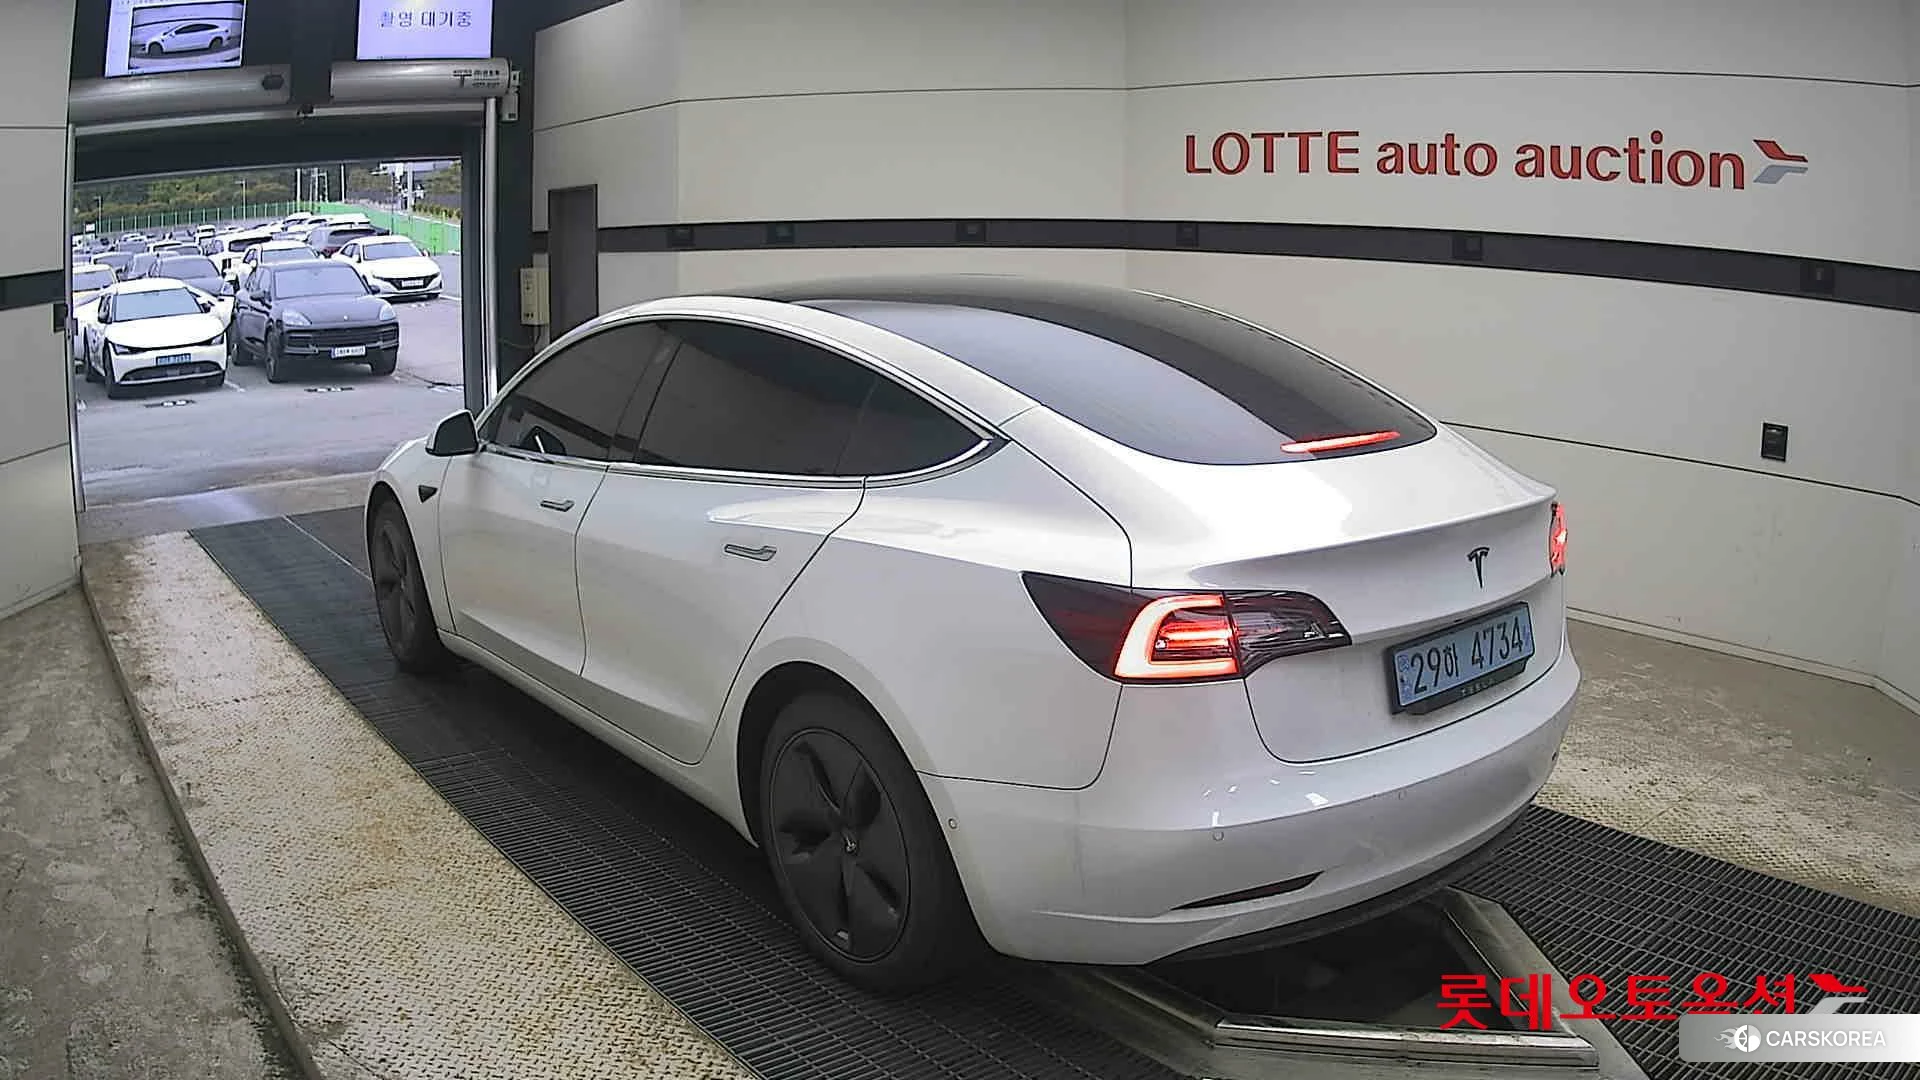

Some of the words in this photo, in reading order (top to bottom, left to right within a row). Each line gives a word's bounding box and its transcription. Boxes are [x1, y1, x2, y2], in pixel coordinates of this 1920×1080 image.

[421, 10, 472, 28] 대기중
[1185, 131, 1360, 175] LOTTE
[1376, 133, 1499, 177] auto
[1513, 130, 1746, 190] auction
[1410, 642, 1459, 695] 29하
[1471, 615, 1524, 670] 4734
